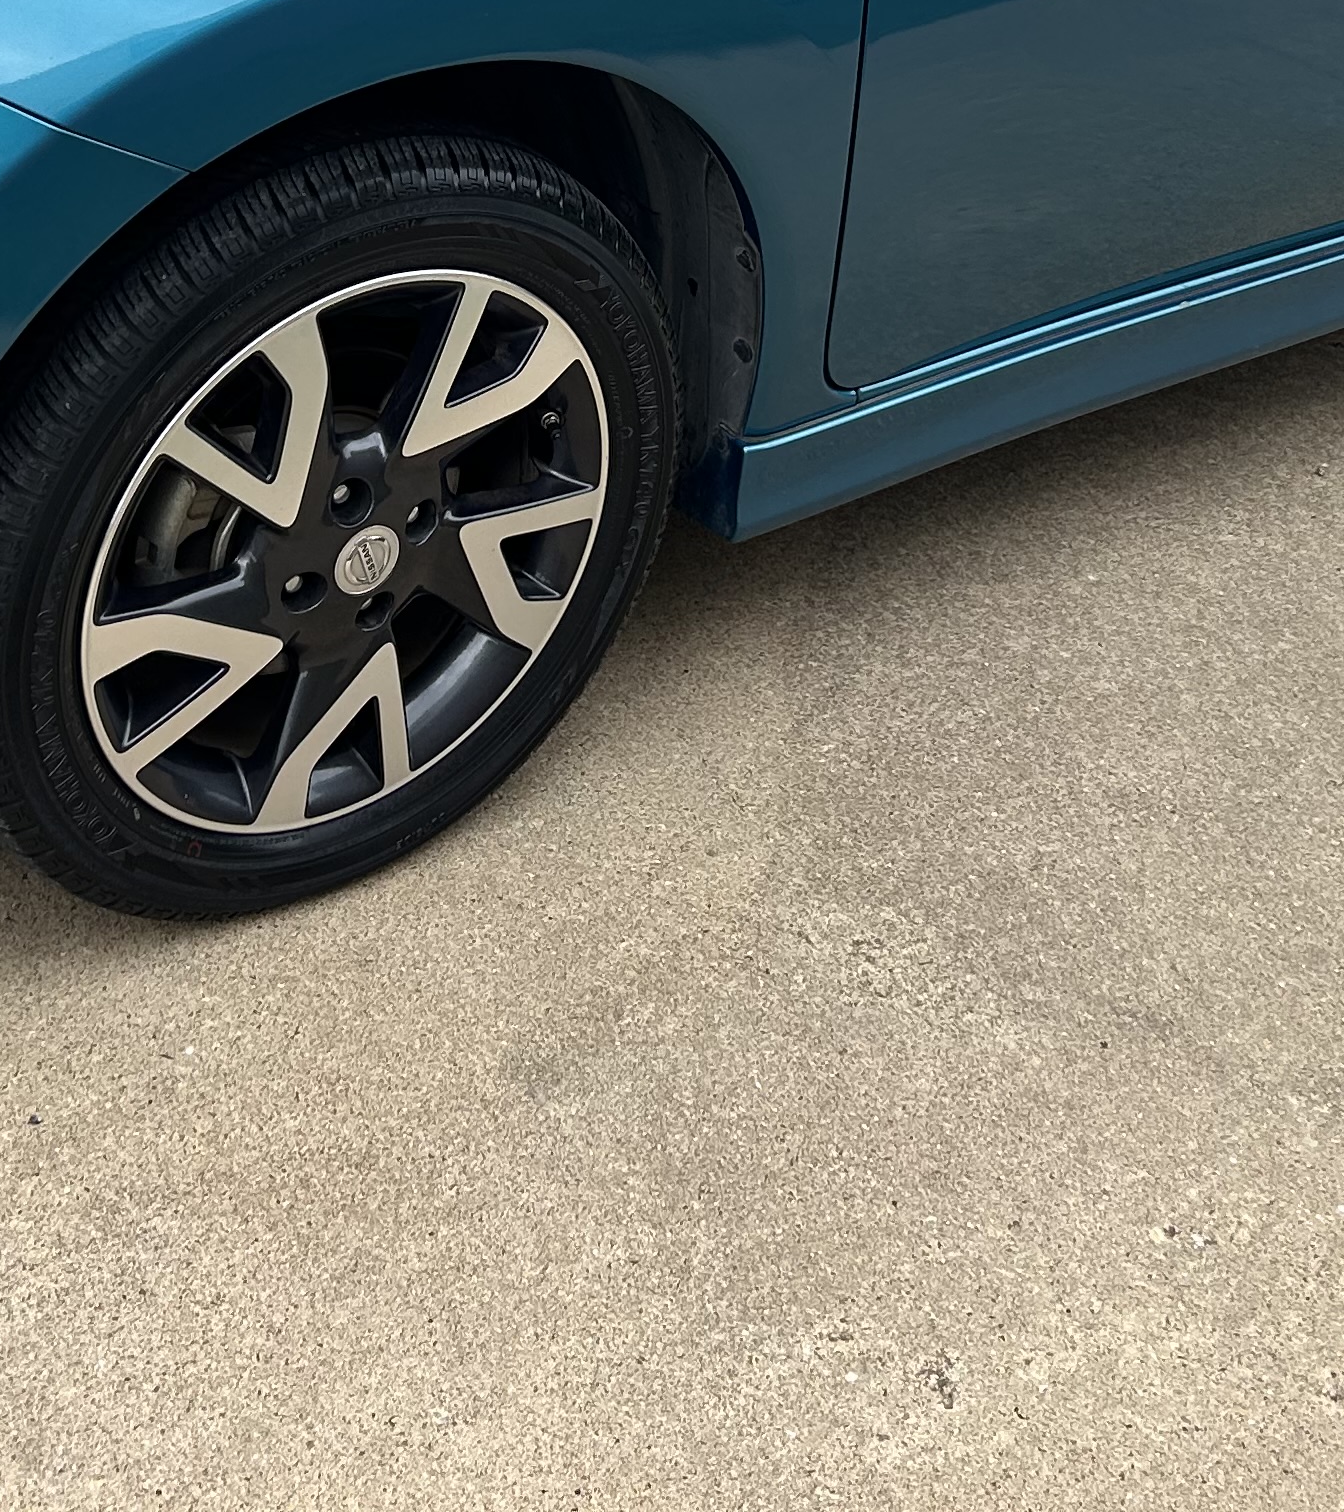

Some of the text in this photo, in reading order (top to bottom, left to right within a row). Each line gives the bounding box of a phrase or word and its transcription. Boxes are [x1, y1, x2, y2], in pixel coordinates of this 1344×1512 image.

[600, 290, 658, 424] YOKOHAMA
[360, 543, 377, 581] NISSAN
[35, 713, 119, 845] YOKOHAMA
